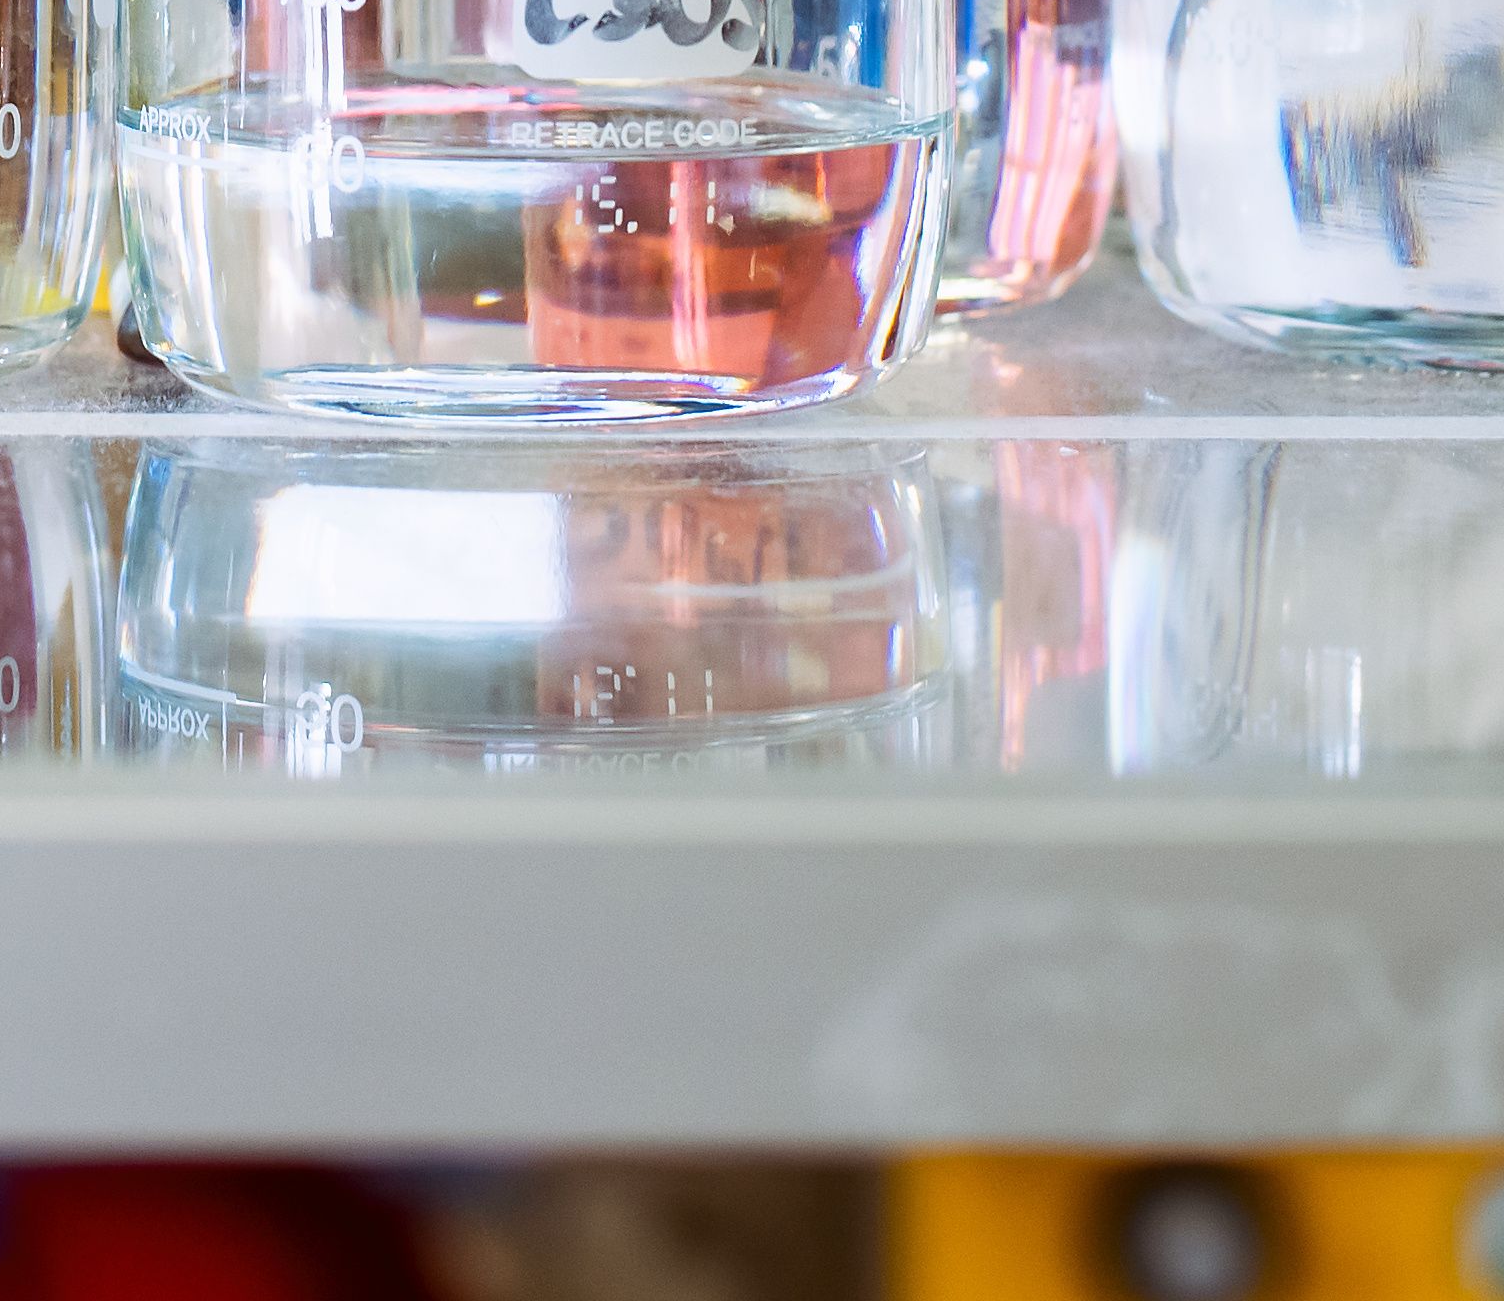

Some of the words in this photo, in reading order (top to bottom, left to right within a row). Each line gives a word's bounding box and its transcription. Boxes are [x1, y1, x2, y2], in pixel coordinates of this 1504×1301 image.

[139, 103, 212, 144] APPROX
[509, 120, 666, 150] RETRACE
[672, 117, 759, 146] CODE
